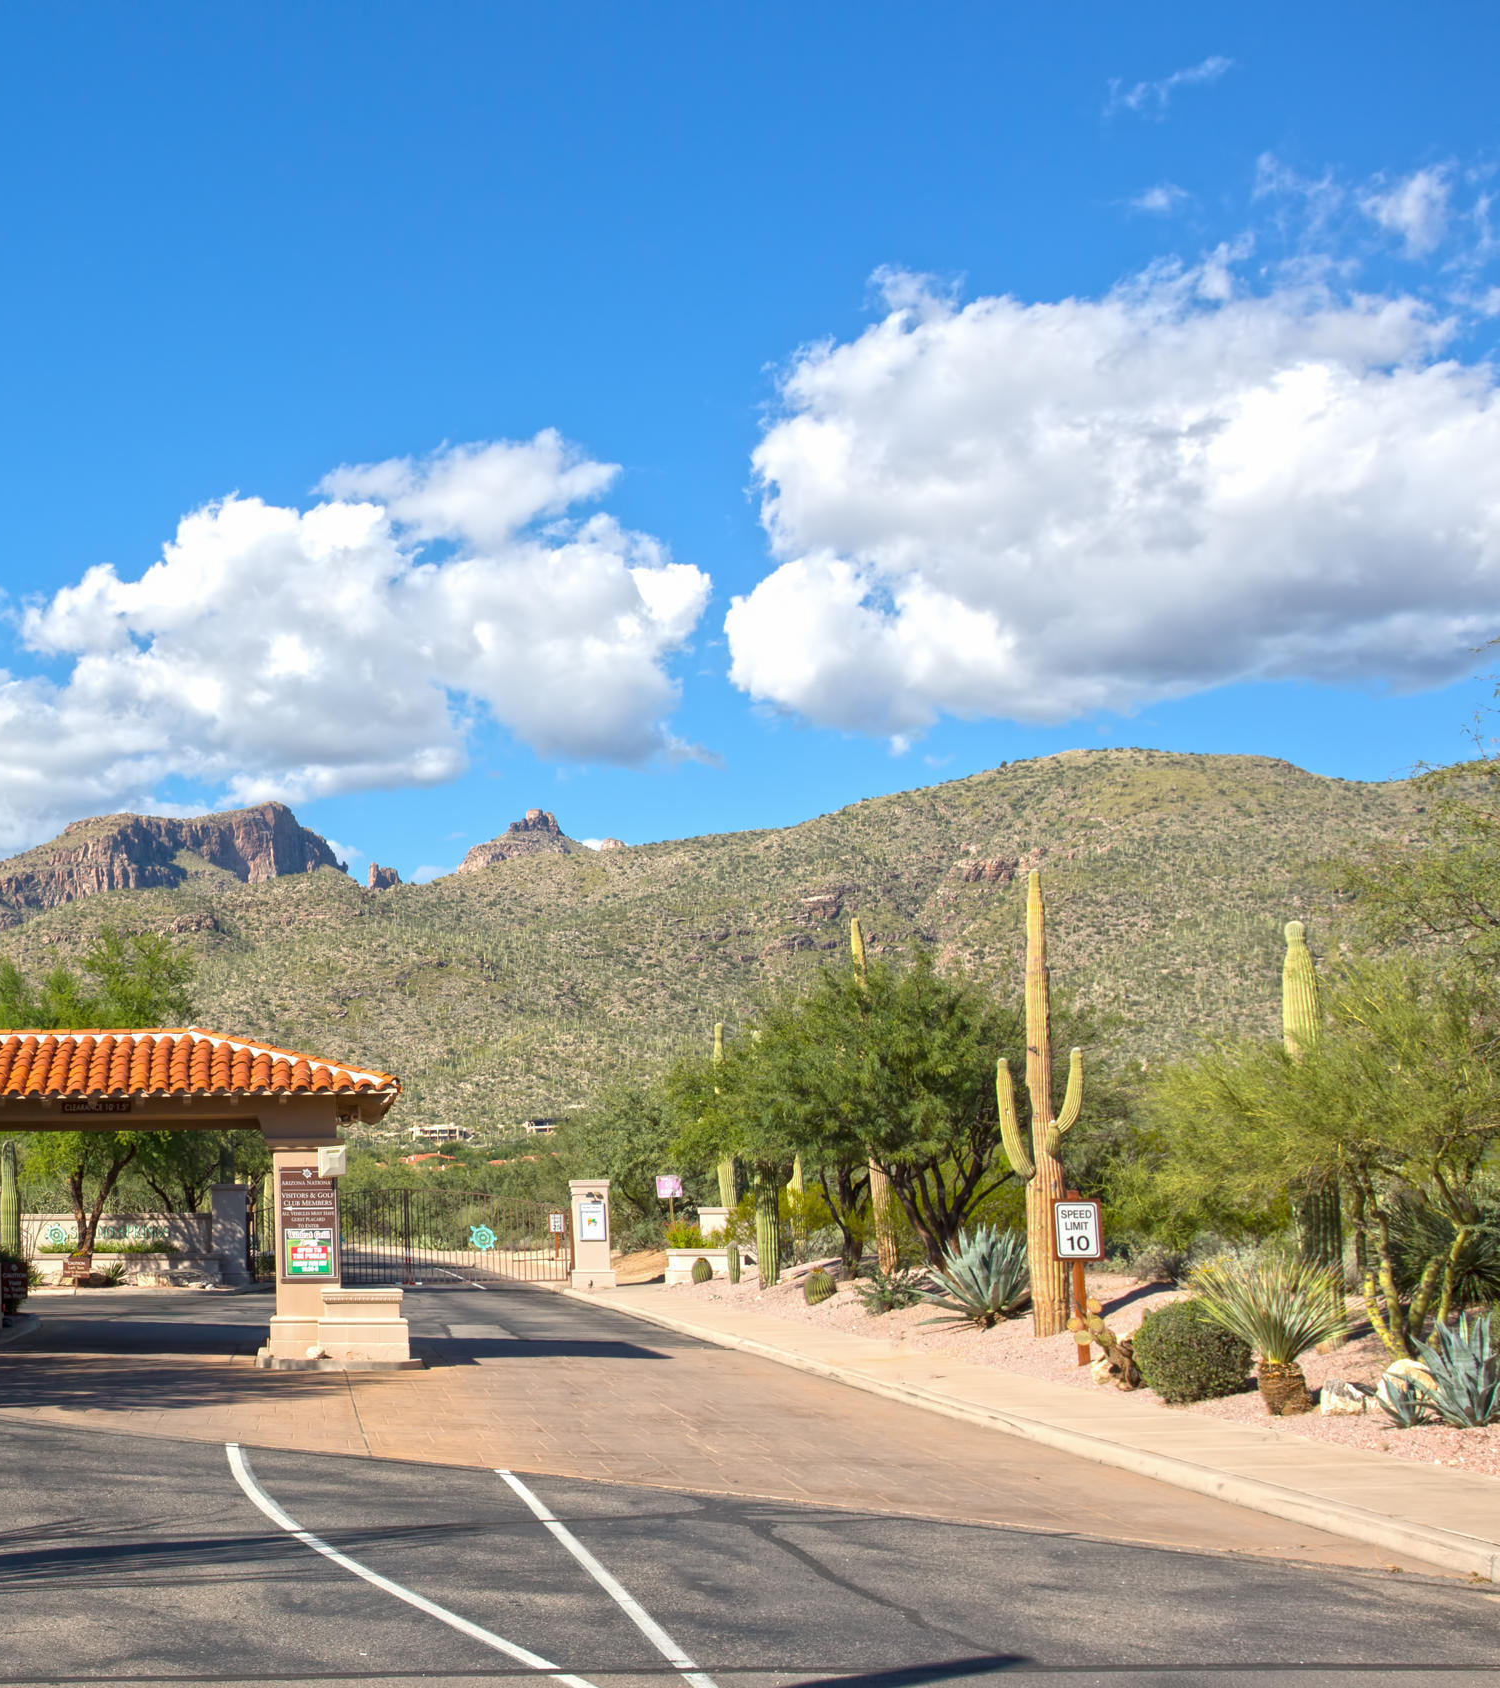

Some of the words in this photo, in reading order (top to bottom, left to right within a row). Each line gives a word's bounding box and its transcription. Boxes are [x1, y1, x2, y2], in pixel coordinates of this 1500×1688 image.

[65, 1104, 102, 1112] CLEARANCE
[1061, 1210, 1092, 1219] SPEED
[1065, 1222, 1089, 1230] LIMIT
[287, 1230, 313, 1239] Wildcat
[314, 1230, 331, 1239] Grill
[1067, 1235, 1090, 1251] 10
